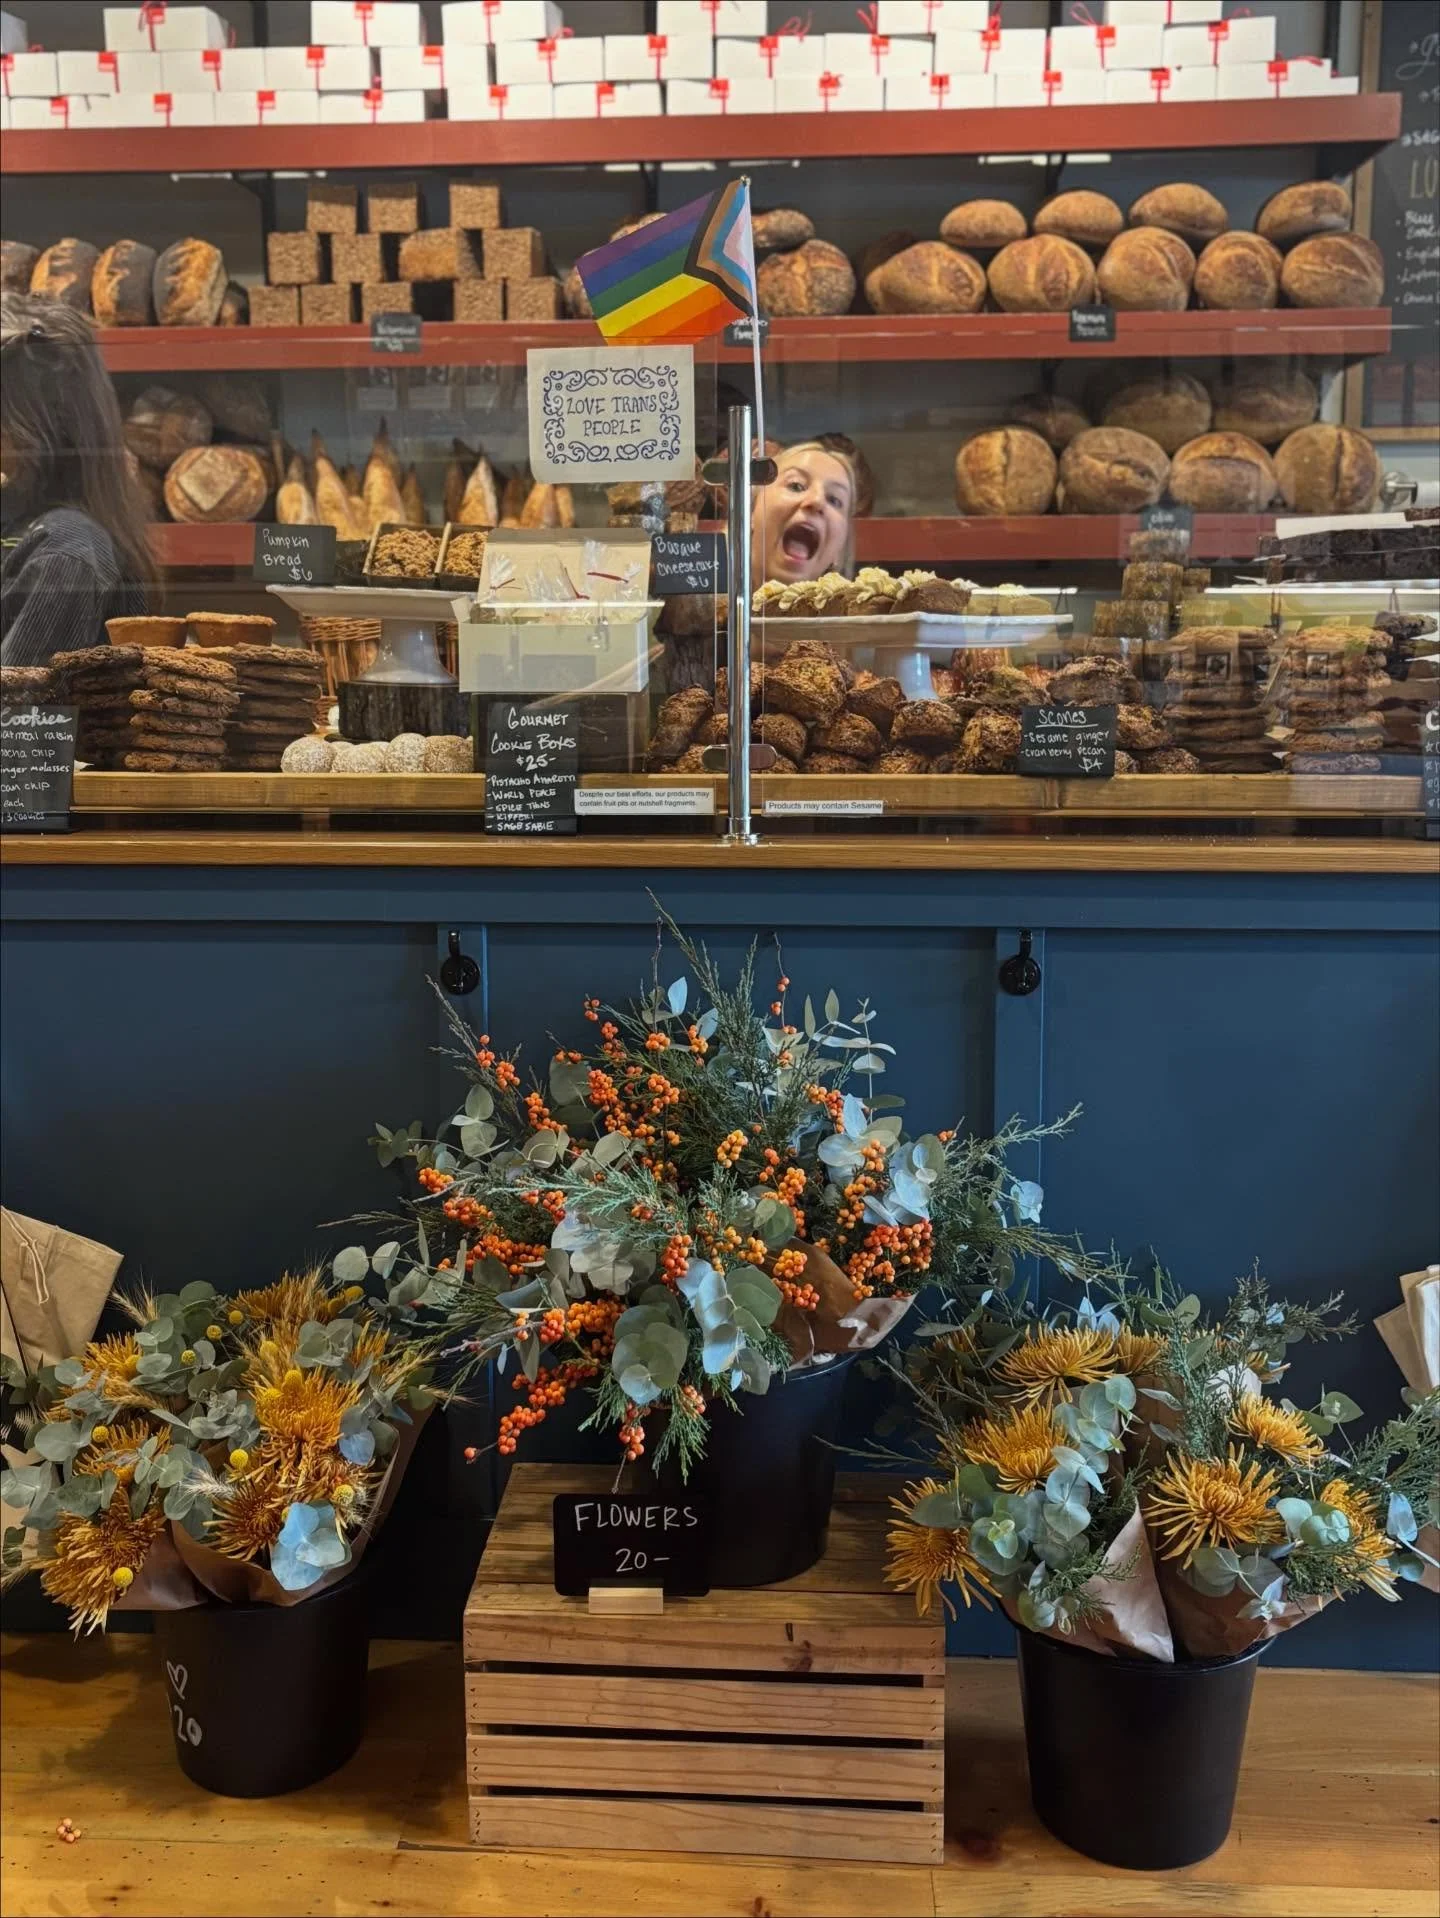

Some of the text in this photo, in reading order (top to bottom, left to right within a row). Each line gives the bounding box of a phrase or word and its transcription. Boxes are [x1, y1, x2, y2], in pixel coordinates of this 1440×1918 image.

[566, 394, 657, 415] LOVE TRANS
[583, 419, 641, 437] PEOPLE
[262, 528, 310, 549] Pumpkin
[654, 536, 701, 556] Basque
[262, 553, 302, 567] Bread
[656, 560, 720, 577] Cheesecake
[288, 566, 313, 581] $6
[0, 706, 72, 727] Cookies
[507, 706, 569, 729] GOURMET
[1038, 708, 1087, 726] Scones
[0, 730, 73, 742] atmeal raisin
[1075, 730, 1110, 746] ginger
[0, 761, 70, 778] inger molasses
[579, 791, 604, 799] Despite
[666, 790, 695, 799] products
[768, 801, 882, 811] Products may contain Sesame
[574, 1502, 698, 1531] FLOWERS
